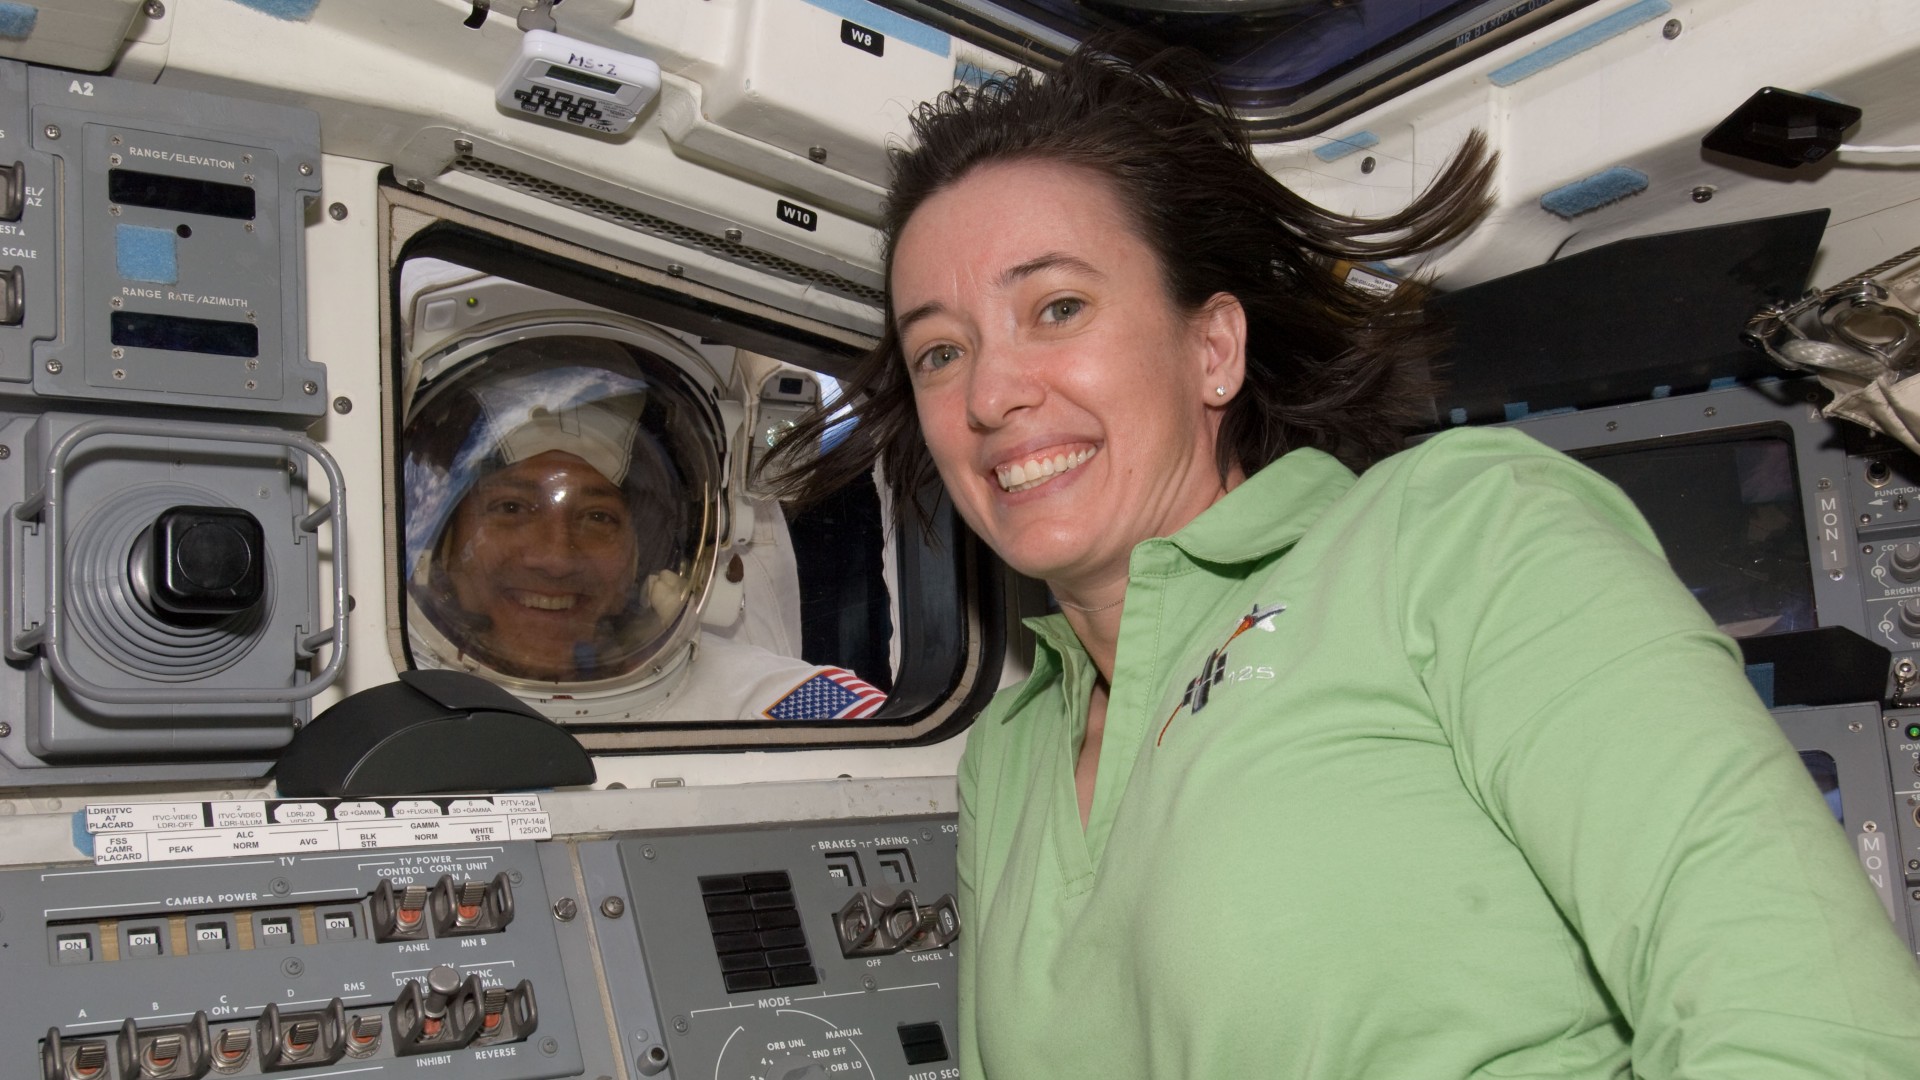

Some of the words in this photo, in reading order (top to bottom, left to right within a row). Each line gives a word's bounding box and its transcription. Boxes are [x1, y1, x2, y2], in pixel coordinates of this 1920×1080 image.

[851, 28, 872, 46] W8
[567, 53, 617, 76] MS-2
[69, 80, 95, 97] A2
[129, 146, 236, 170] RANGE/ELEVATION
[25, 187, 45, 196] EL/
[26, 197, 43, 207] AZ
[783, 205, 810, 225] W10
[2, 247, 37, 259] SCALE
[122, 287, 162, 299] RANGE
[1830, 549, 1837, 561] 1
[1228, 665, 1275, 685] 125
[218, 811, 262, 819] ITVC-VIDEO
[89, 821, 134, 830] PLACARD
[410, 821, 440, 829] GAMMA
[940, 824, 959, 833] SOF
[236, 831, 254, 839] ALC
[469, 827, 494, 835] WHITE
[110, 837, 128, 845] FSS
[299, 838, 318, 846] AVG
[475, 834, 491, 842] STR
[874, 836, 909, 847] SAFING
[168, 845, 194, 853] PEAK
[233, 841, 259, 849] NORM
[361, 840, 377, 848] STR
[818, 839, 857, 850] BRAKES
[105, 845, 133, 854] CAMR
[97, 853, 142, 863] PLACARD
[279, 856, 296, 867] TV
[399, 858, 412, 866] TV
[416, 855, 452, 865] POWER
[376, 866, 425, 877] CONTROL
[429, 864, 462, 873] CONTR
[466, 862, 488, 871] UNIT
[391, 876, 414, 885] CMD
[166, 895, 213, 907] CAMERA
[218, 892, 258, 902] POWER
[330, 919, 346, 928] ON
[267, 925, 284, 934] ON
[202, 930, 218, 940] ON
[64, 941, 82, 950] ON
[134, 936, 151, 945] ON
[461, 939, 477, 948] MN
[480, 937, 487, 946] B
[398, 943, 430, 953] PANEL
[866, 958, 882, 967] OFF
[911, 953, 942, 963] CANCEL
[344, 982, 365, 992] RMS
[287, 989, 295, 997] D
[220, 995, 227, 1004] C
[758, 996, 791, 1009] MODE
[152, 1002, 159, 1011] B
[212, 1005, 230, 1015] ON
[78, 1009, 87, 1018] A
[825, 1028, 863, 1040] MANUAL
[767, 1042, 786, 1051] ORB
[788, 1039, 806, 1049] UNL
[475, 1047, 517, 1061] REVERSE
[812, 1050, 830, 1059] END
[833, 1047, 847, 1056] EFF
[416, 1055, 452, 1068] INHIBIT
[831, 1062, 849, 1072] ORB
[851, 1060, 862, 1070] LD
[941, 1068, 960, 1079] SEQ
